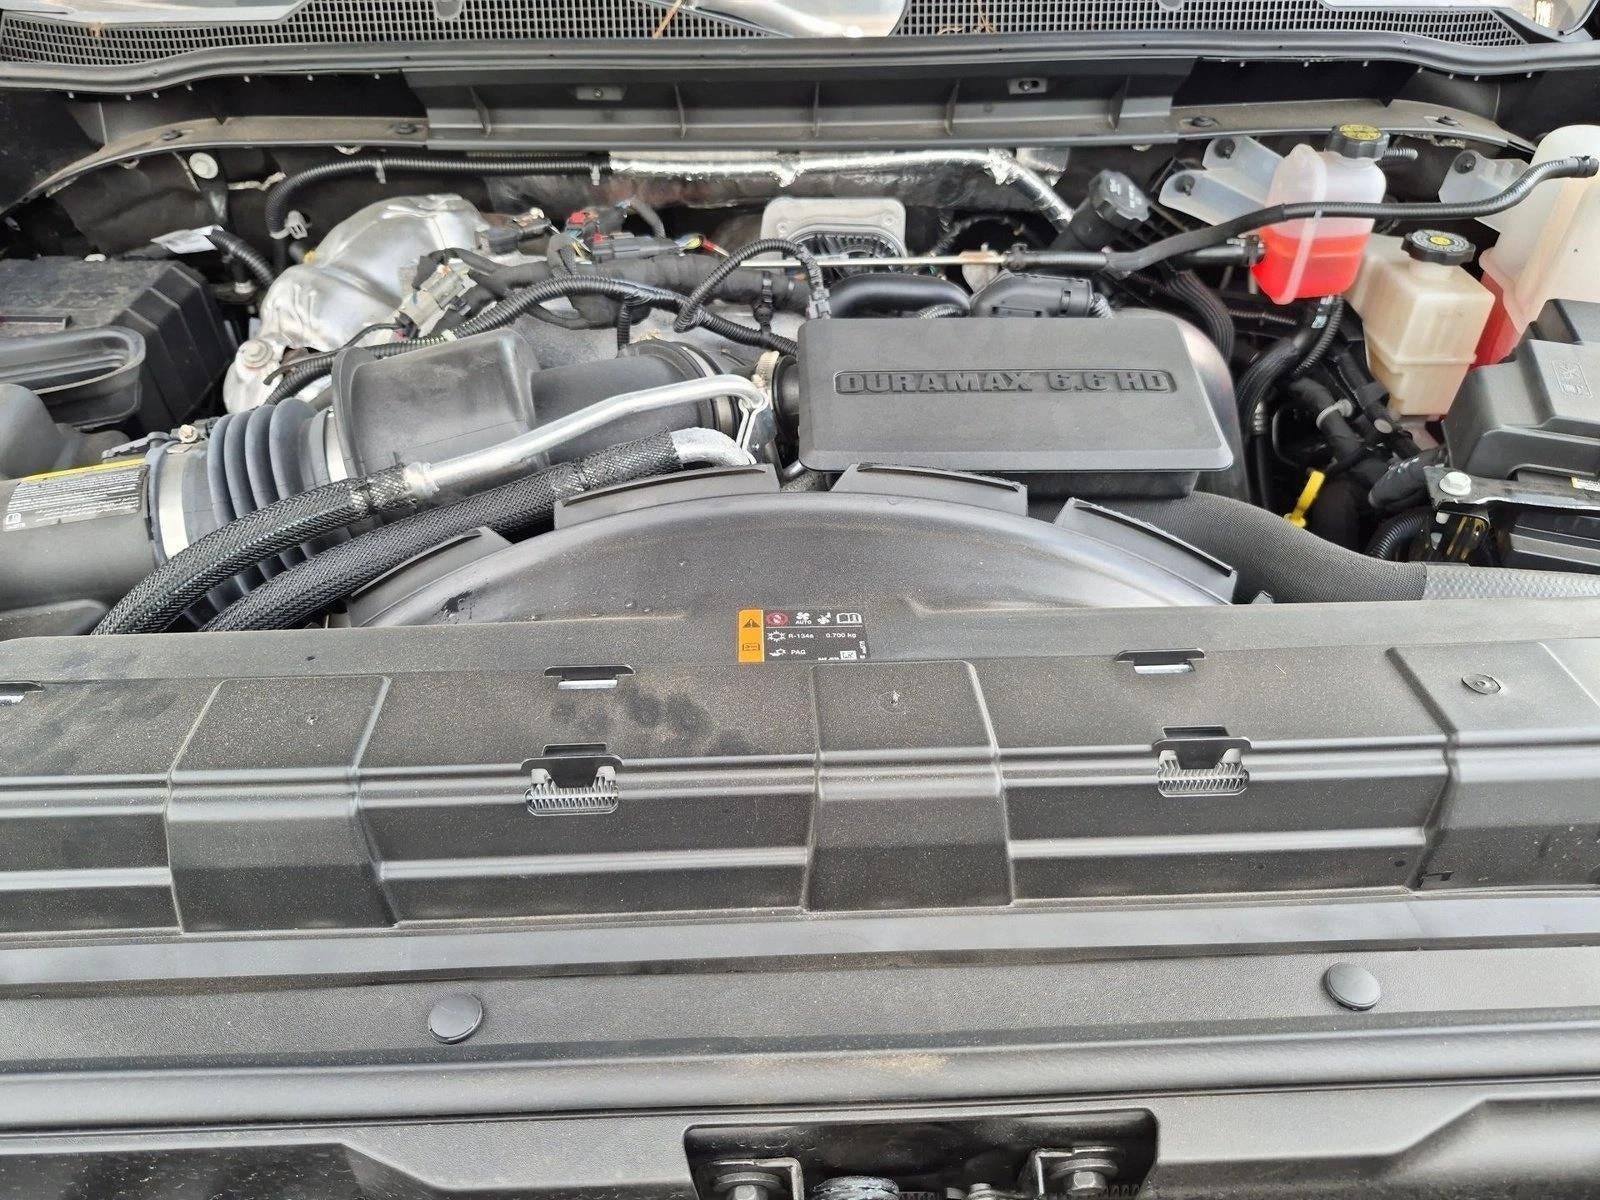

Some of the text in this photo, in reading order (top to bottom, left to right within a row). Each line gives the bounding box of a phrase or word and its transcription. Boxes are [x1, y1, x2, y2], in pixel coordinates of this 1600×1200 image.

[838, 371, 1170, 393] DURAMAX 6.6 HD
